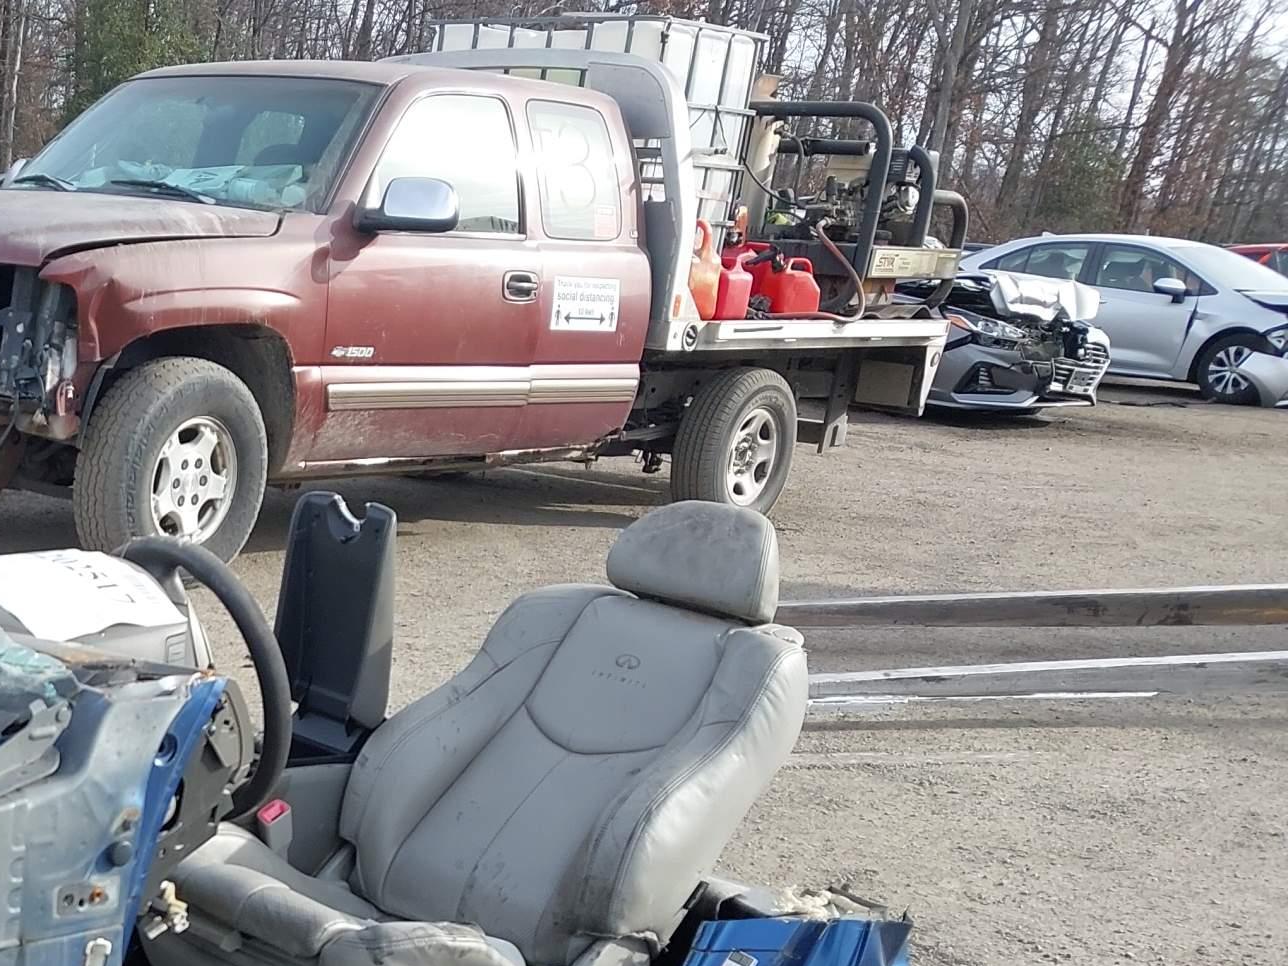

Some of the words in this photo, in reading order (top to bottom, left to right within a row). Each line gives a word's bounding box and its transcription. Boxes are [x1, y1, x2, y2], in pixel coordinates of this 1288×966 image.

[557, 291, 578, 301] social
[579, 292, 616, 305] distancing
[345, 346, 375, 358] 1500
